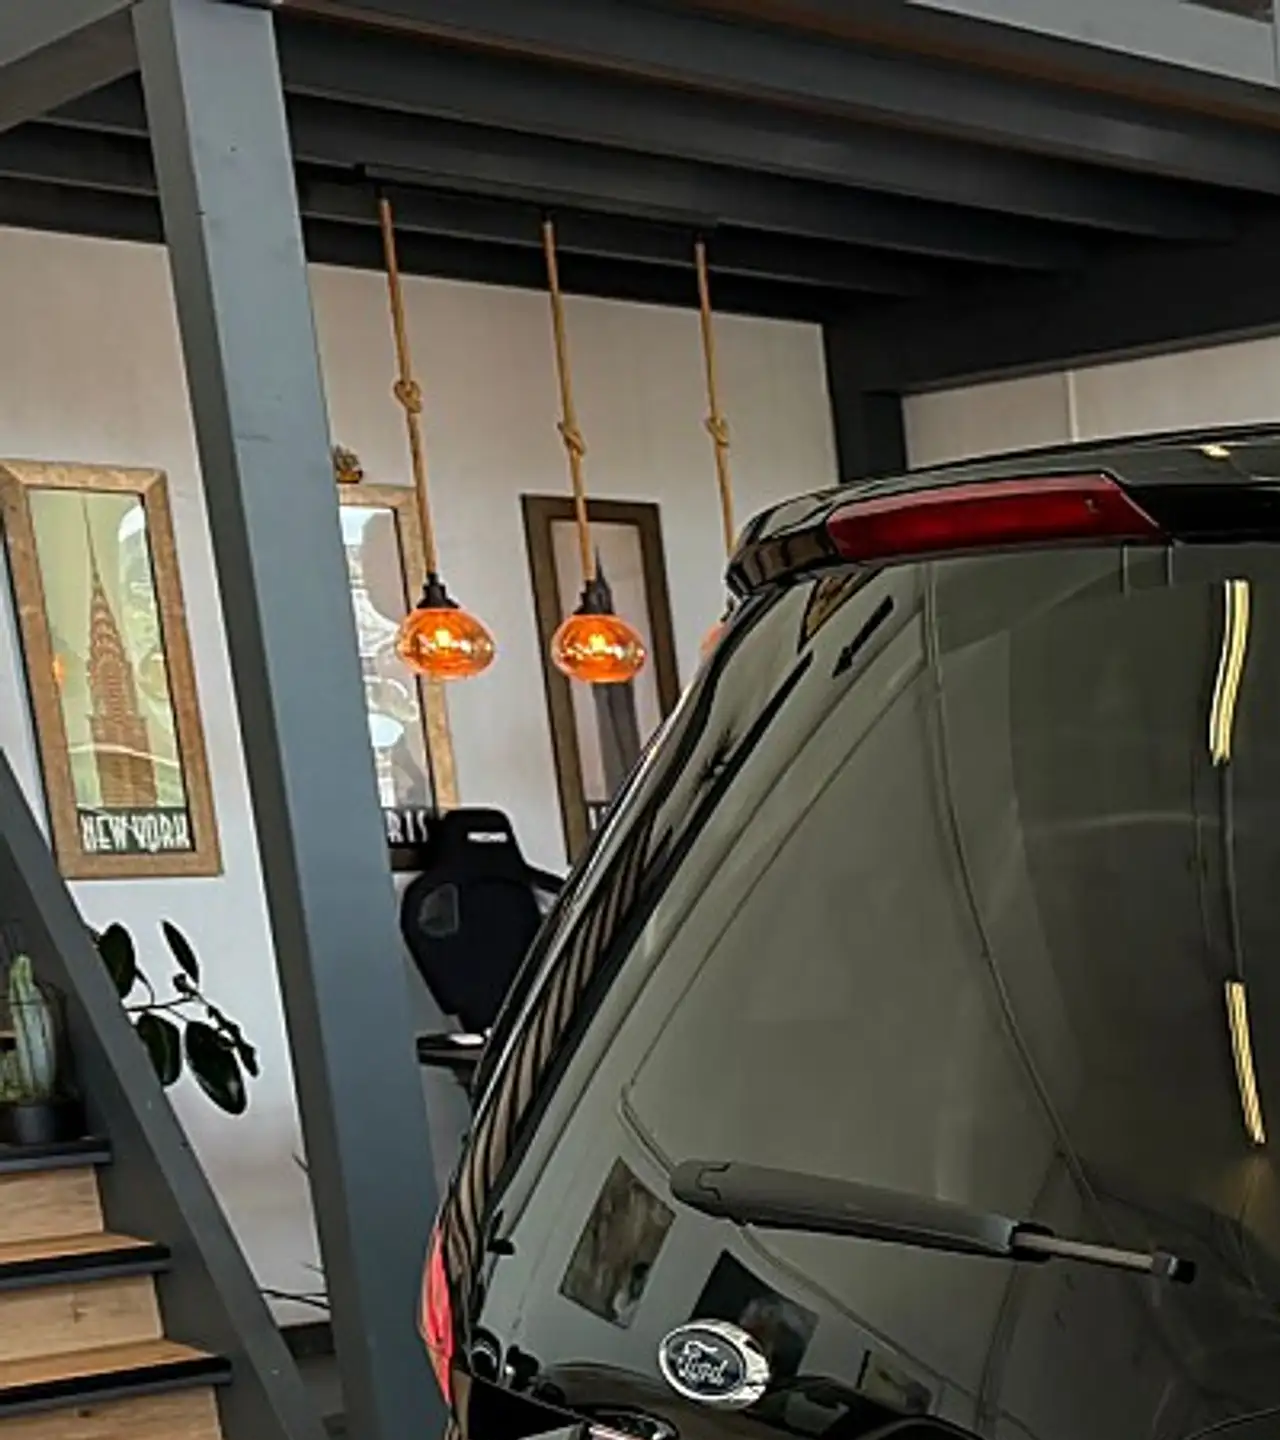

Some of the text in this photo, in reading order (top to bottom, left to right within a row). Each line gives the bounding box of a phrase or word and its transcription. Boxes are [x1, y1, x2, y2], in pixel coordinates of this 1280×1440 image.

[80, 813, 191, 852] NEW YORK
[385, 809, 428, 843] RIS
[678, 1340, 728, 1387] Ford
